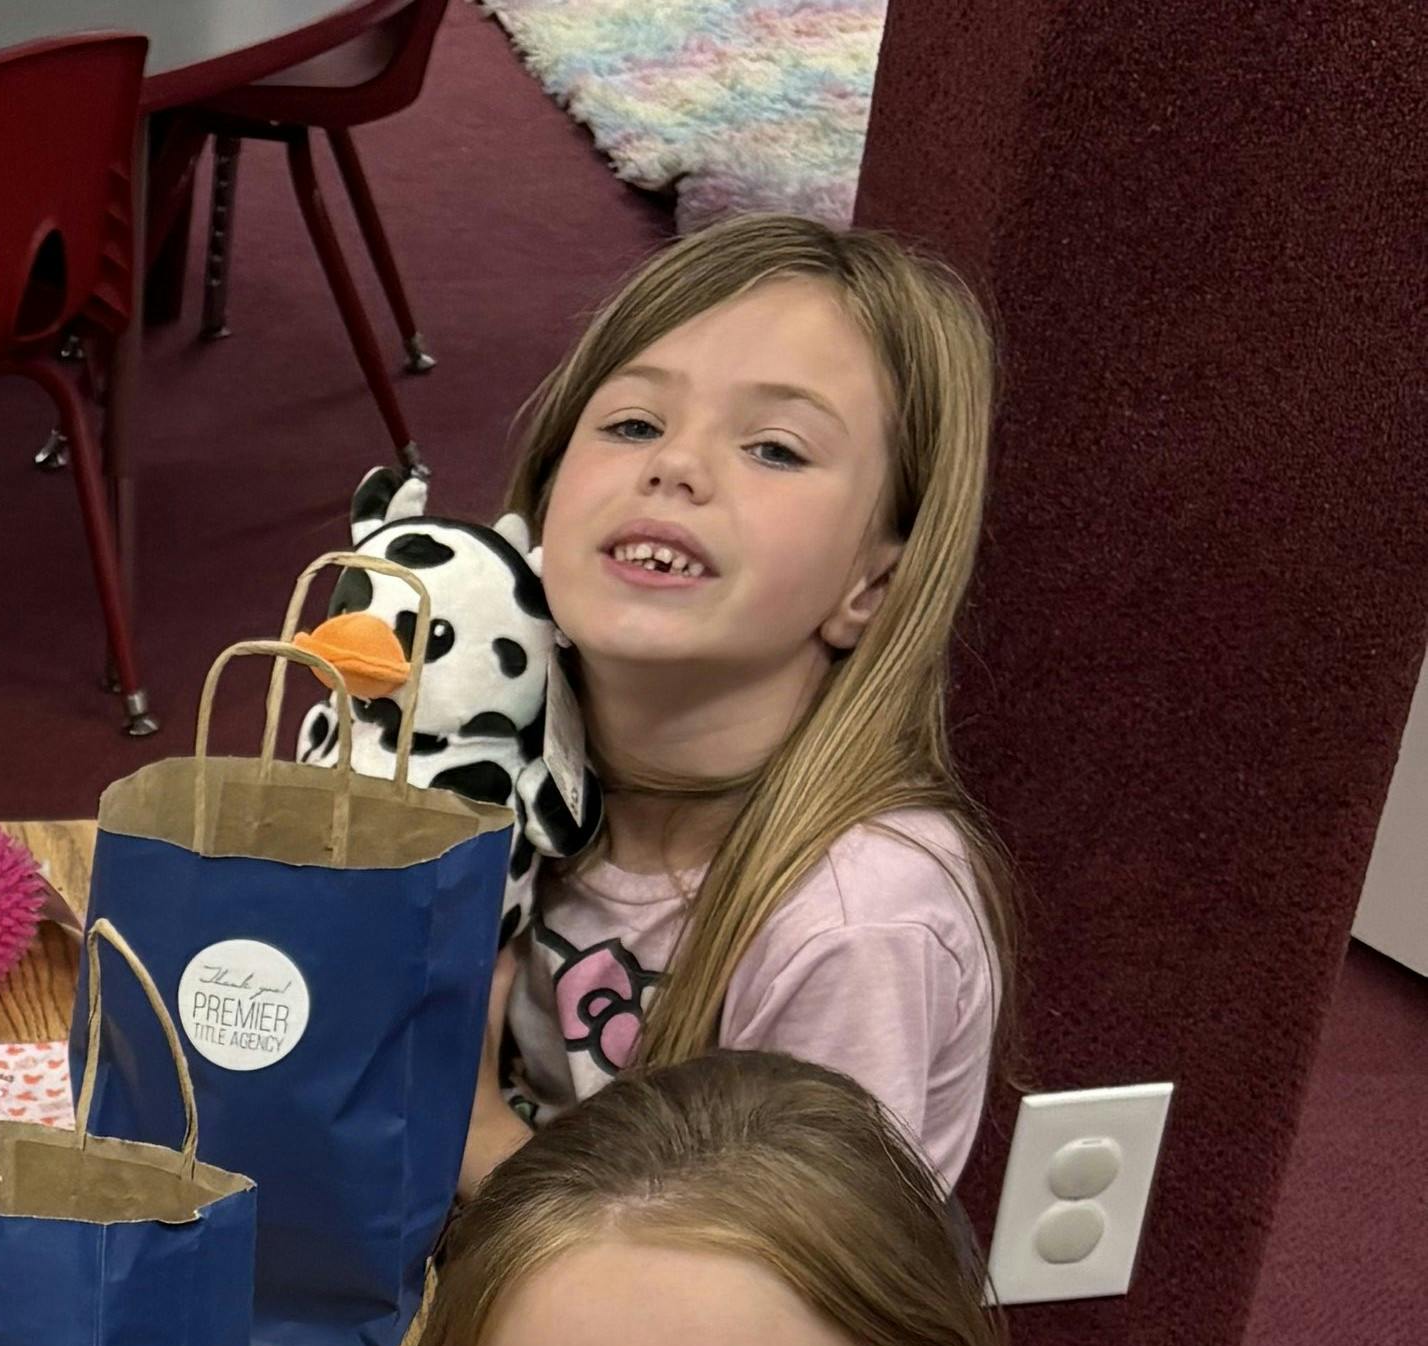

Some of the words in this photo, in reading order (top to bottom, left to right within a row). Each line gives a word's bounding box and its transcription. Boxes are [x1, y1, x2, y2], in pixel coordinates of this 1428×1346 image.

[193, 991, 290, 1034] PREMIER
[194, 1022, 226, 1045] TITLE
[230, 1030, 286, 1053] AGENCY
